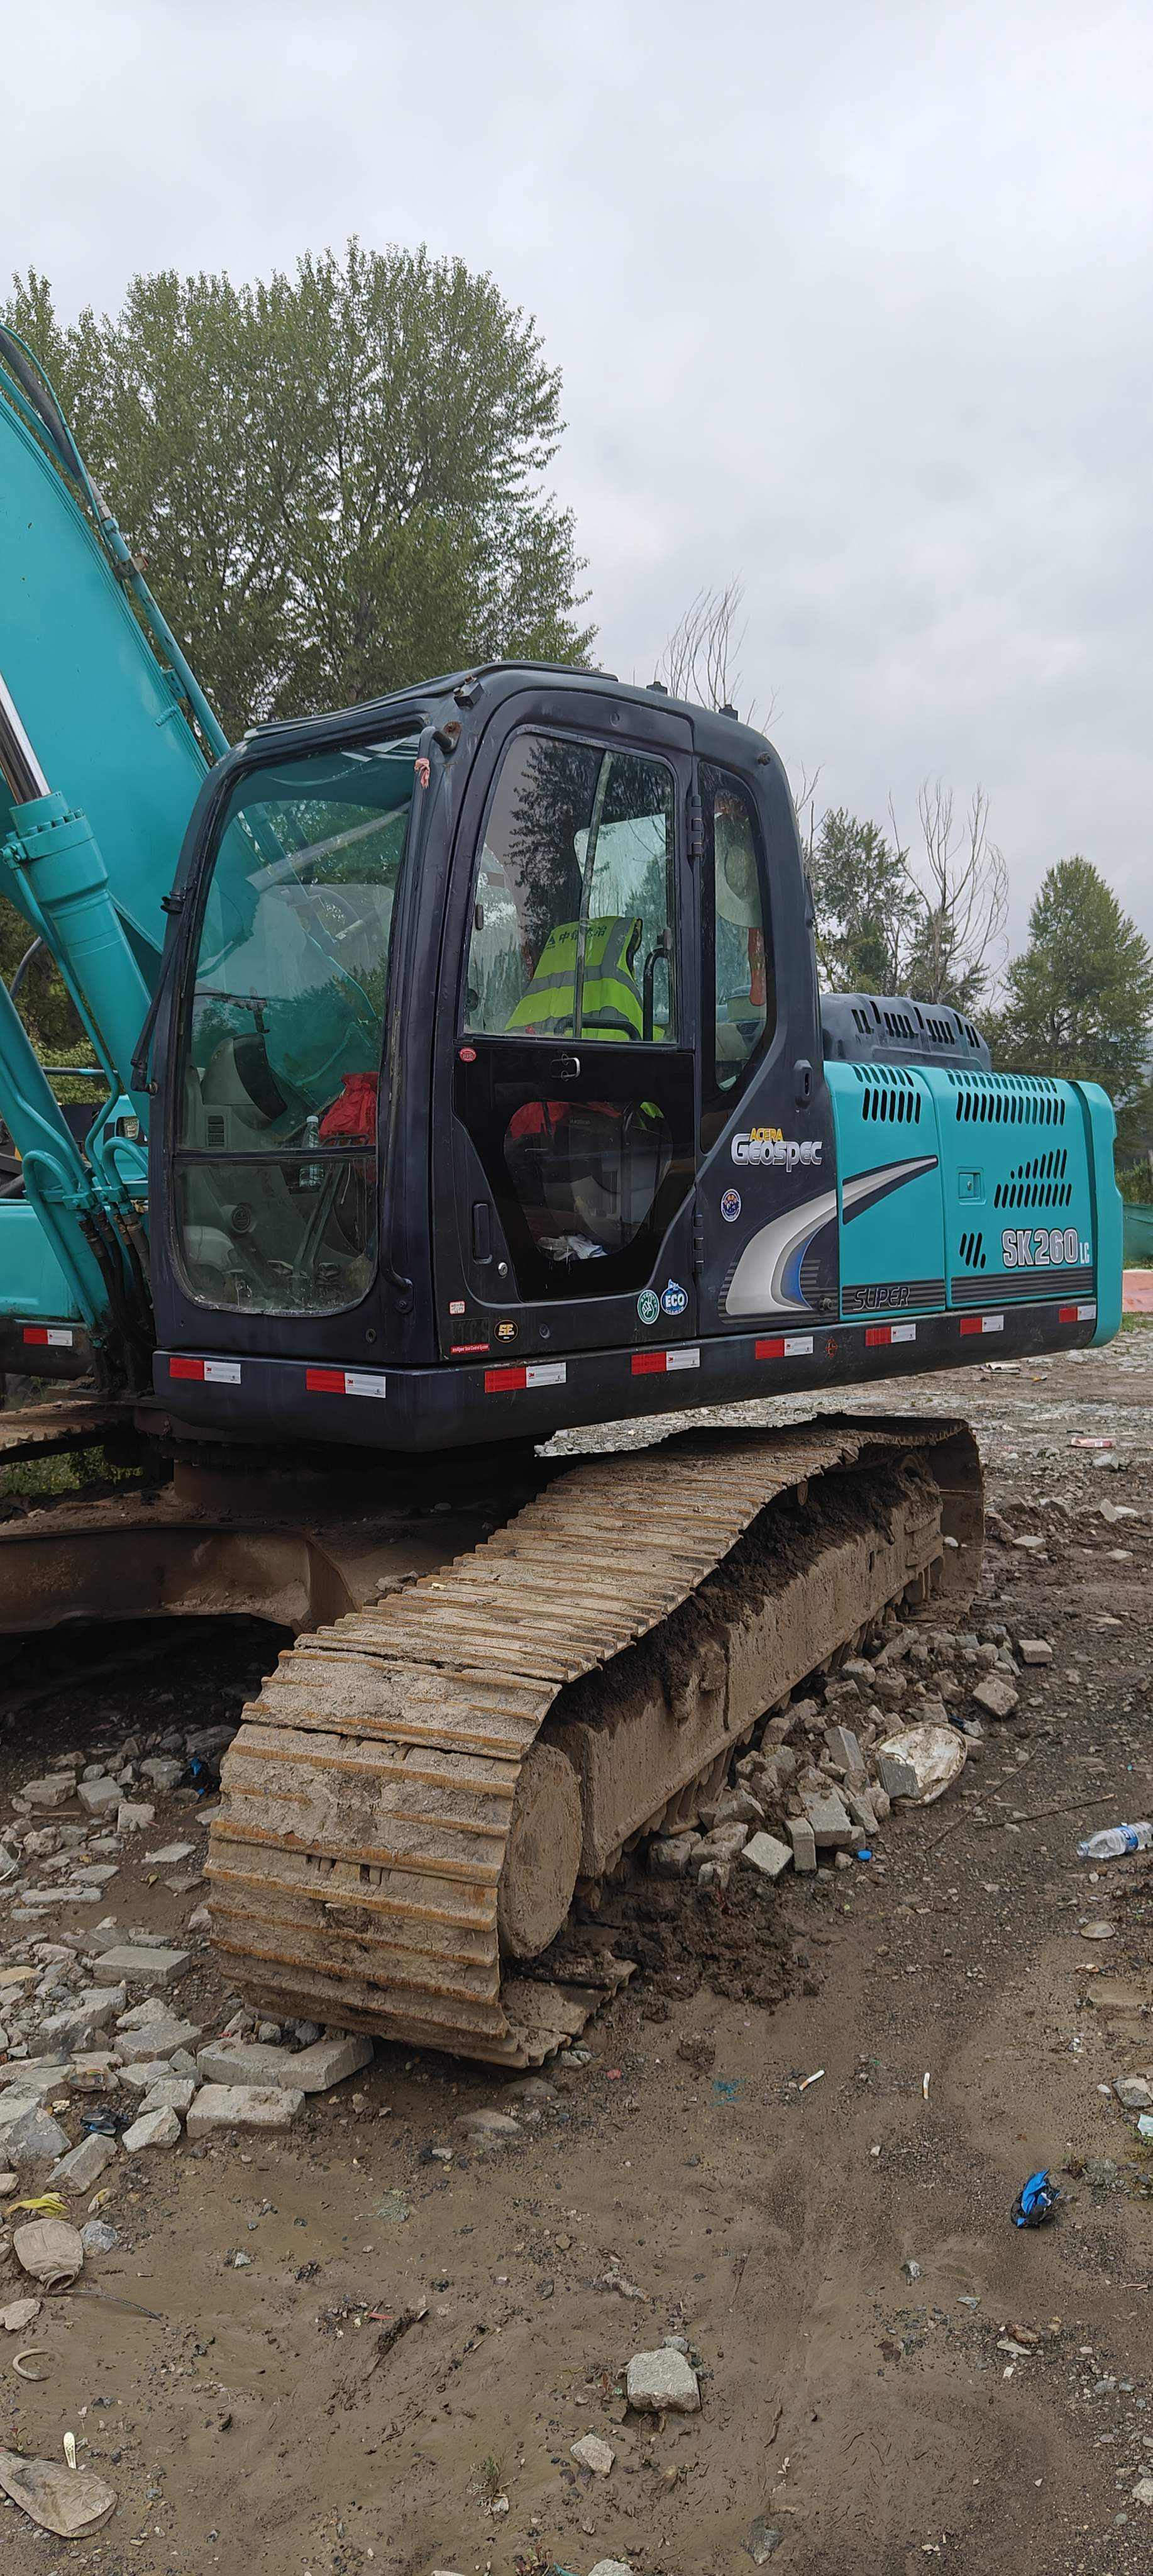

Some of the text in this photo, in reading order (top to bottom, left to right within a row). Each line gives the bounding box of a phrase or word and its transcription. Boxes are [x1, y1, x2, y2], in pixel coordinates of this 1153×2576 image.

[749, 1128, 784, 1141] ACERA
[1002, 1228, 1090, 1268] SK260 LC
[665, 1293, 685, 1308] ECO
[853, 1286, 910, 1311] SUPER
